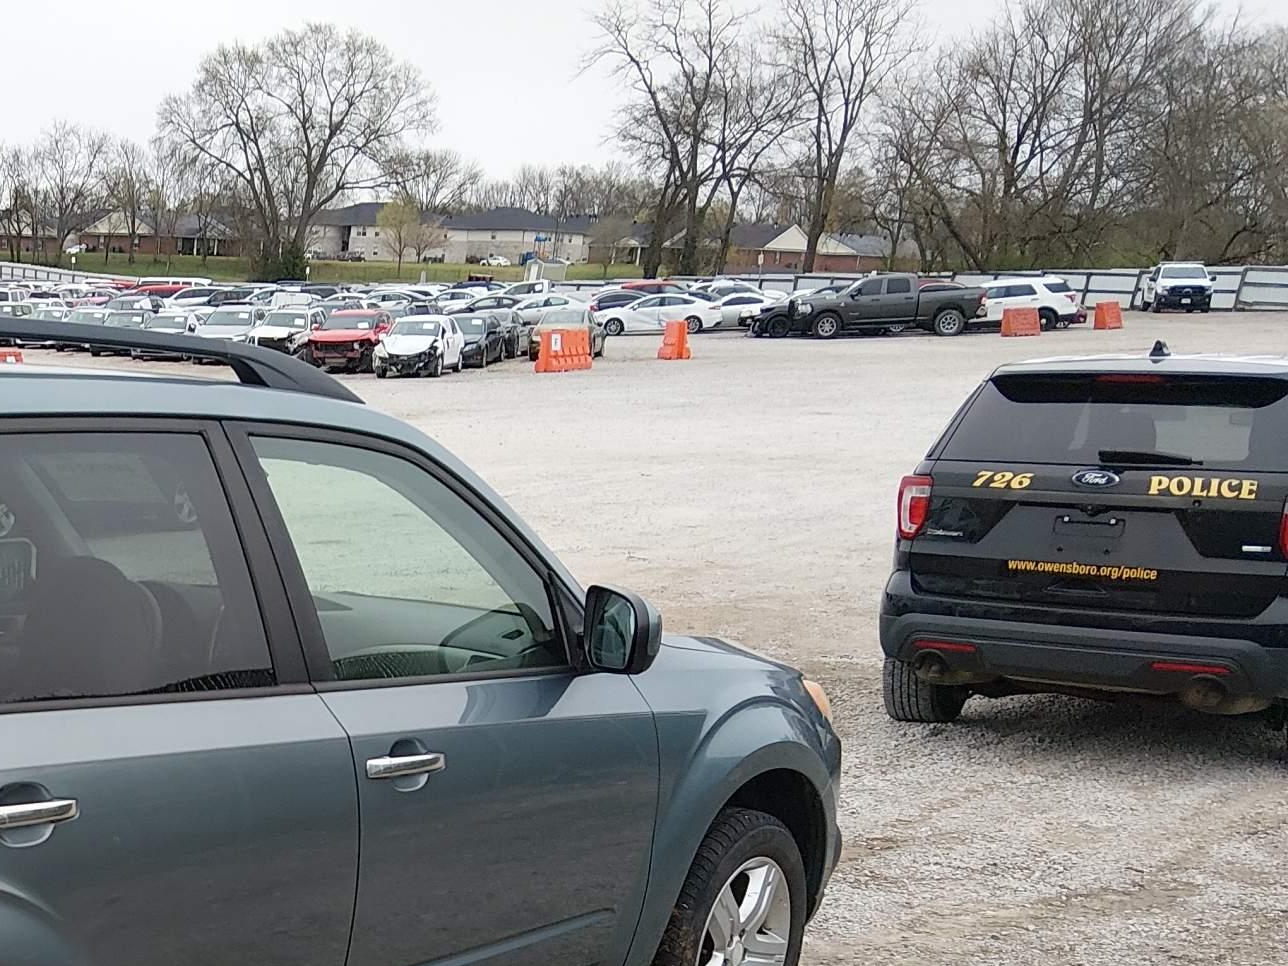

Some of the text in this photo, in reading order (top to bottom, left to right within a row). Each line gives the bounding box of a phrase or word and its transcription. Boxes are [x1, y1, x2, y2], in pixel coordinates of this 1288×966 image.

[972, 470, 1035, 489] 726
[1148, 475, 1259, 500] POLICE
[1007, 558, 1158, 580] www.owensboro.org/police
